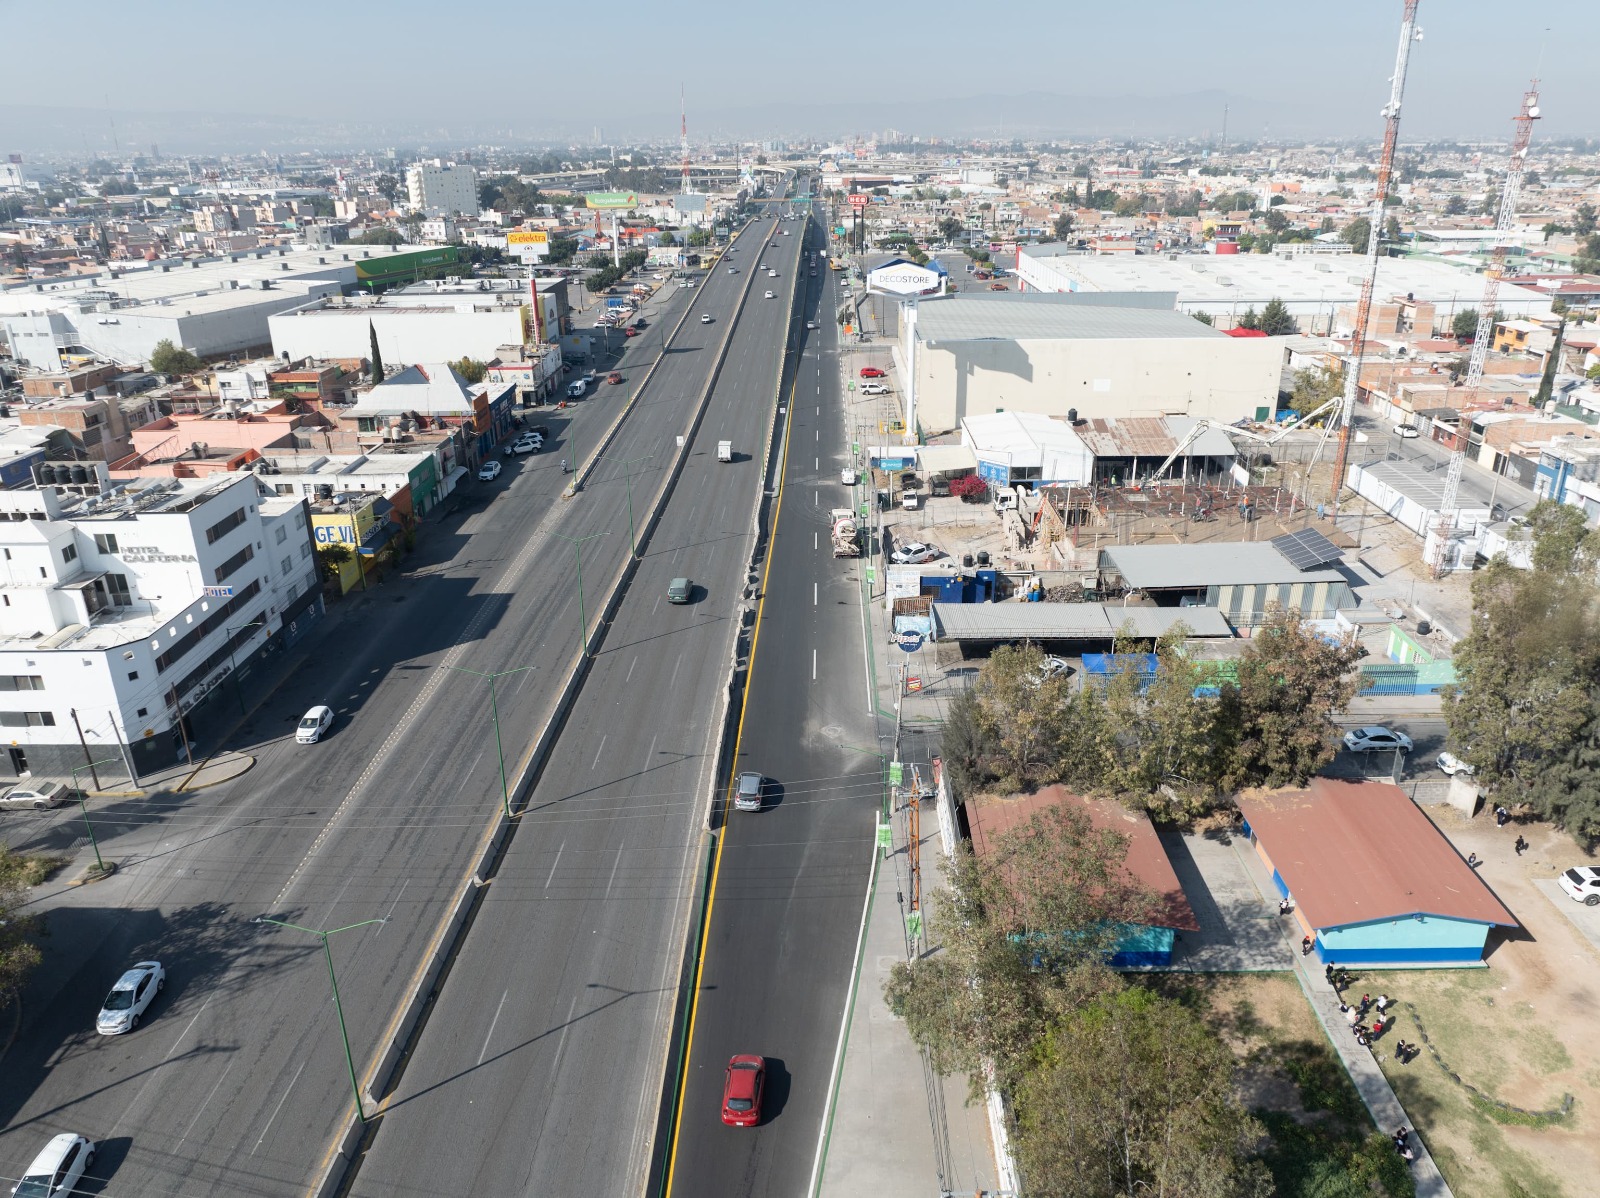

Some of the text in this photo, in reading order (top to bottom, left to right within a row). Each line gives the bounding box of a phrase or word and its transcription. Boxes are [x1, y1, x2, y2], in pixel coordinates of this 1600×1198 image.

[518, 234, 546, 242] elektra
[879, 275, 930, 284] DECOSTORE
[120, 546, 164, 555] HOTEL
[122, 554, 199, 563] CALIFORNIA
[204, 587, 233, 597] HOTEL
